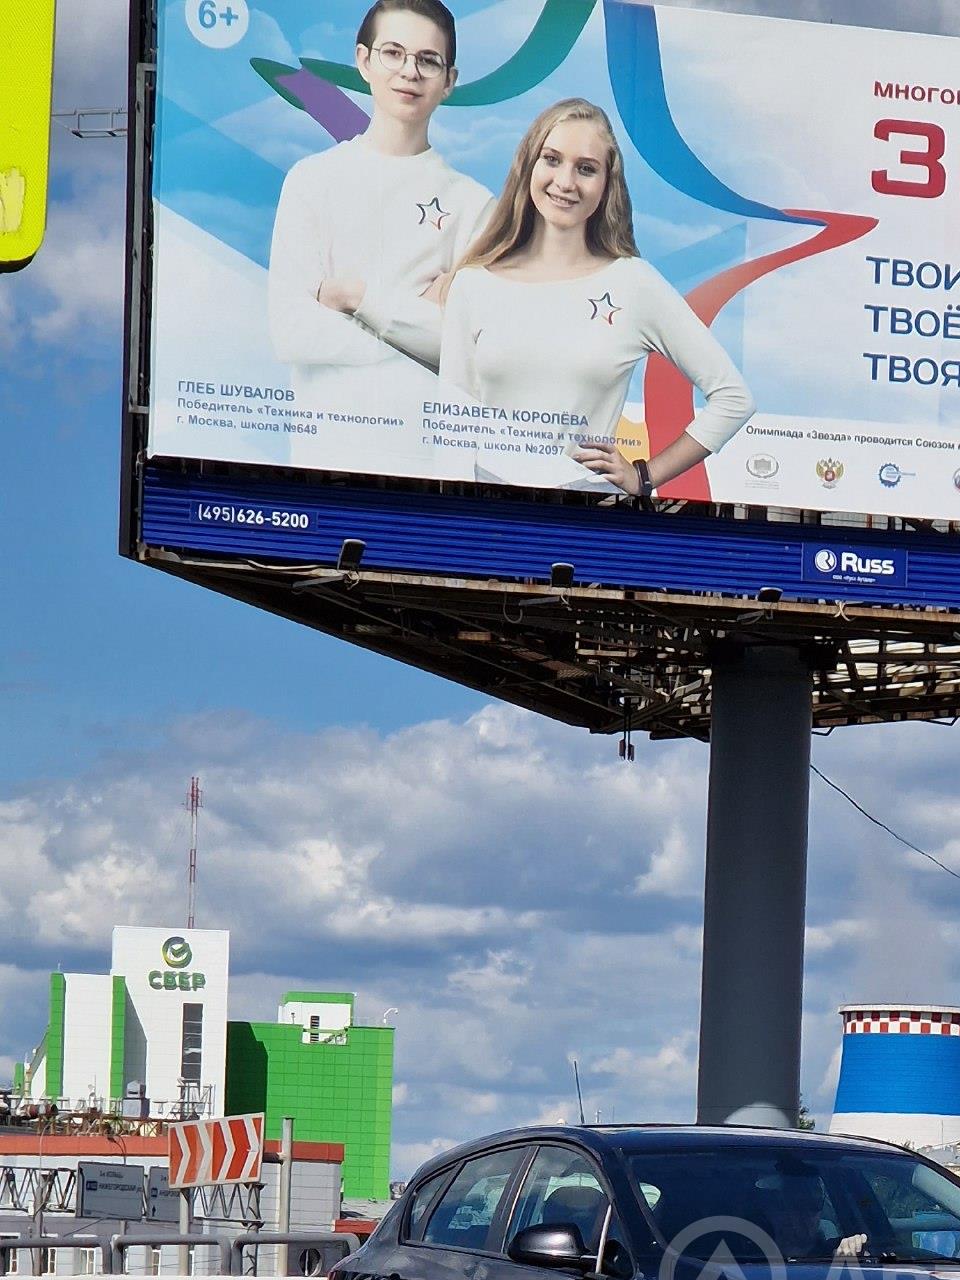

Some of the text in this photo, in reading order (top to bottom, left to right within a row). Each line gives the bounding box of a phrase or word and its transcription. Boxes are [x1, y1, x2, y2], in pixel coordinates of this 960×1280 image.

[199, 0, 239, 29] 6+
[178, 380, 295, 401] ГЛЕБ ШУВАЛОВ
[177, 398, 405, 427] Победитель «Техника и технологии»
[423, 401, 589, 427] ЕЛИЗАВЕТА КОРОЛЁВА
[176, 415, 318, 435] г. Москва, школа №648
[422, 419, 642, 447] Победитель «Техника и технологии»
[422, 435, 565, 456] г. Москва, школа №2097
[745, 425, 804, 440] Олимпиада
[806, 430, 852, 442] «Звезда»
[854, 435, 913, 448] проводится
[915, 438, 955, 450] Союзом
[841, 551, 895, 575] Russ
[148, 970, 206, 992] СБЕР
